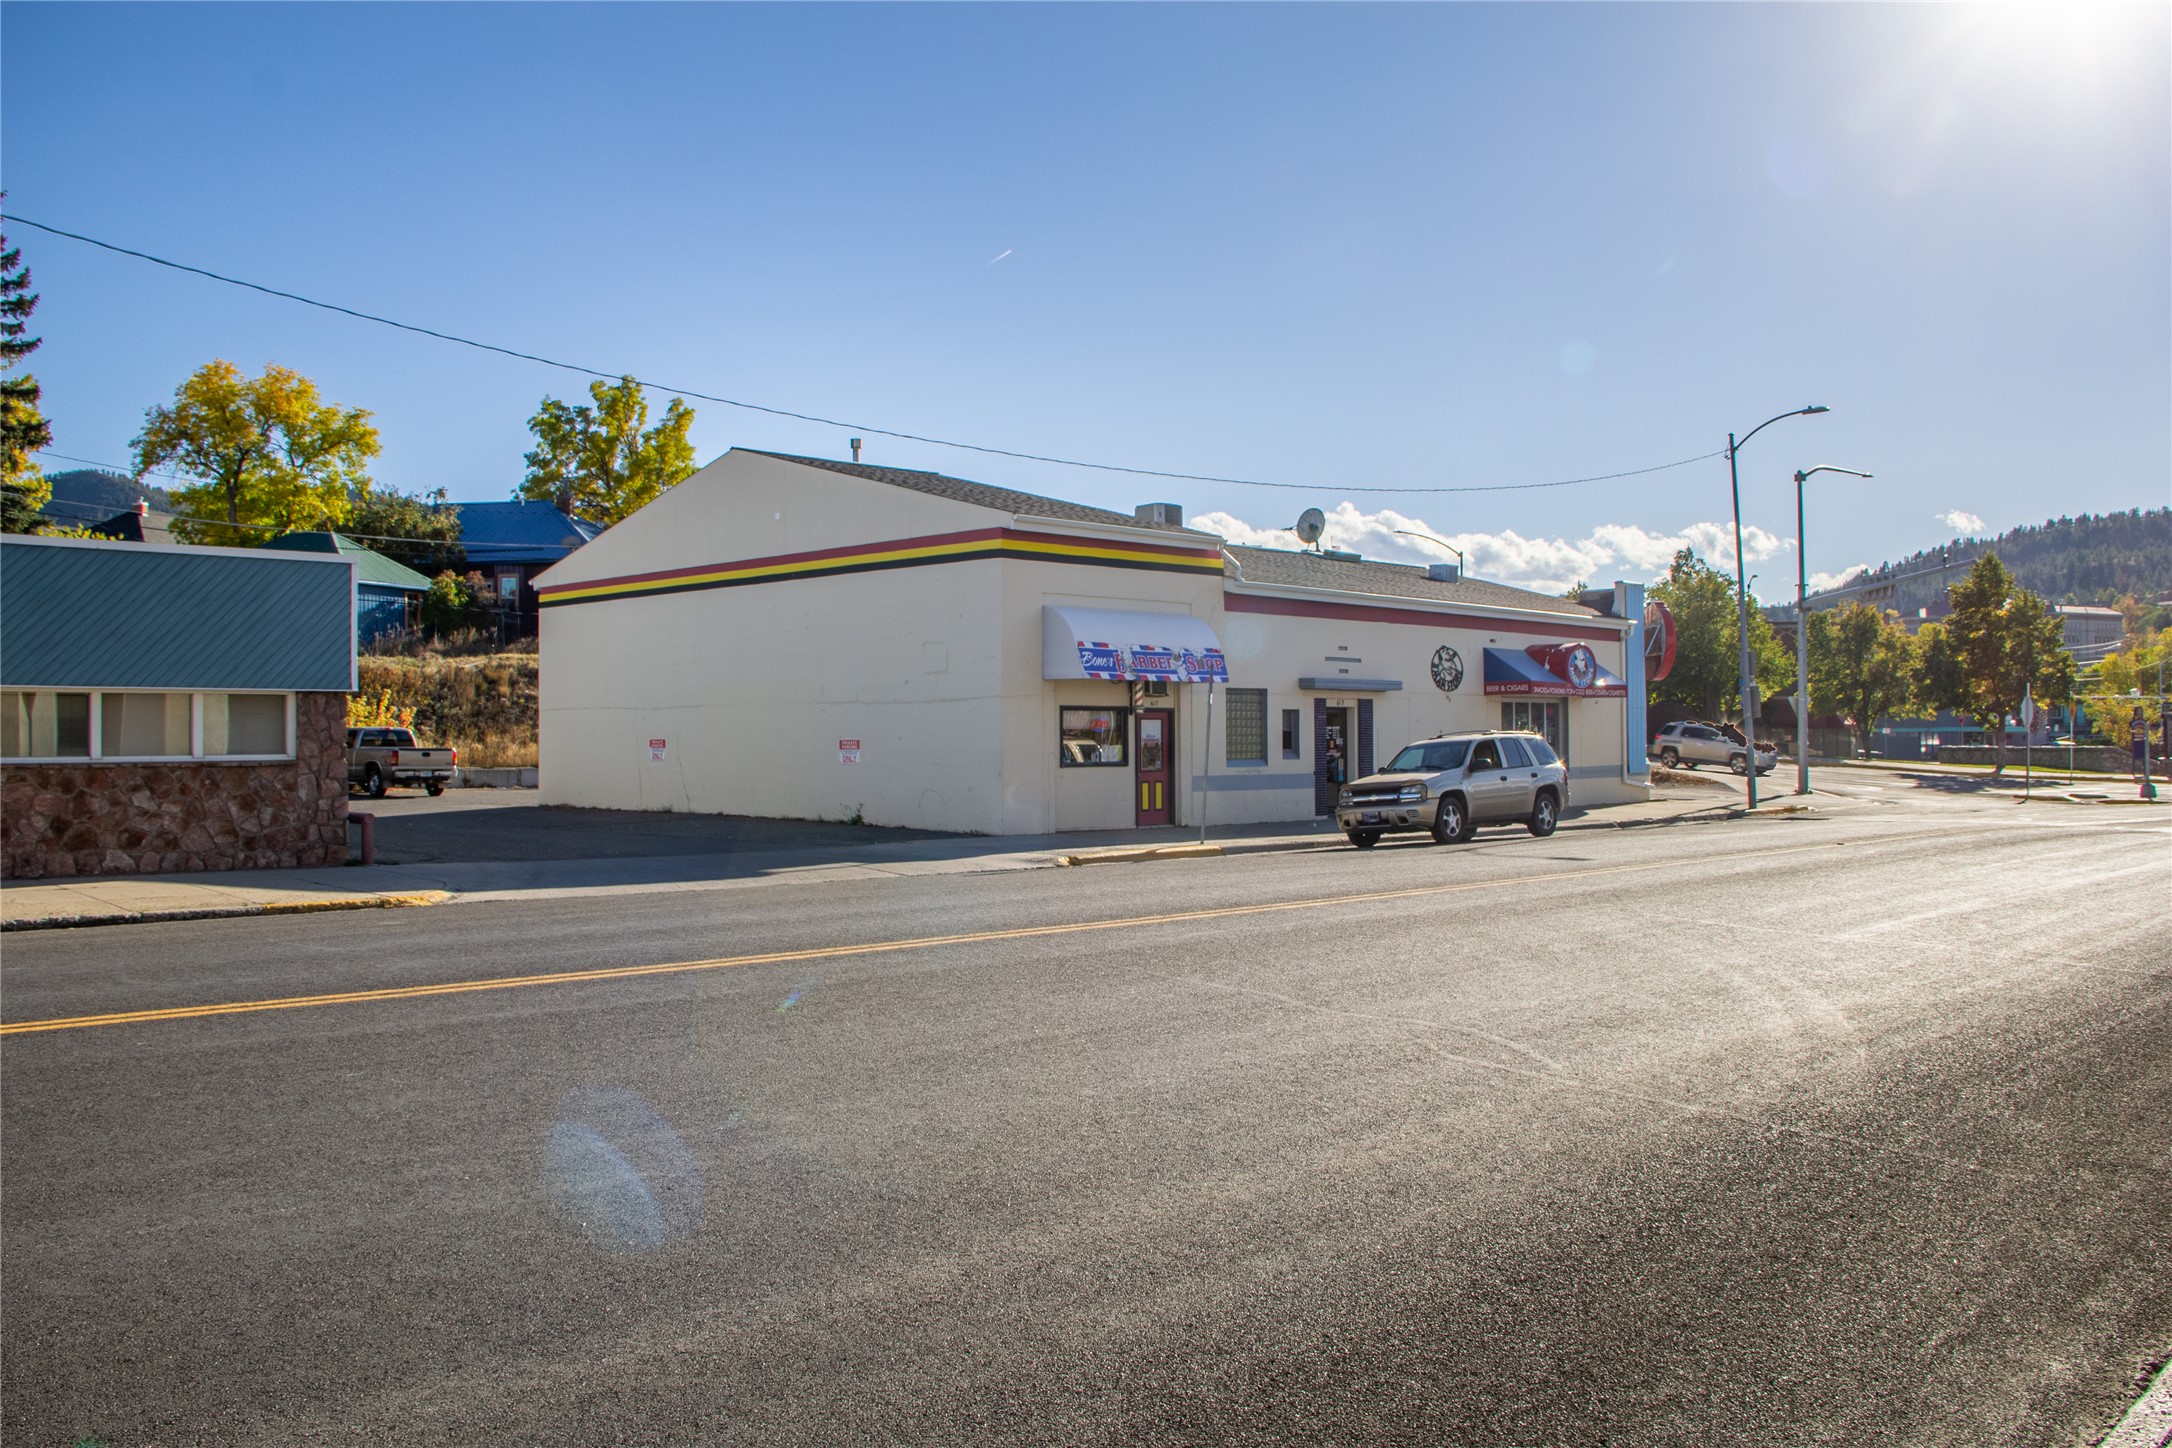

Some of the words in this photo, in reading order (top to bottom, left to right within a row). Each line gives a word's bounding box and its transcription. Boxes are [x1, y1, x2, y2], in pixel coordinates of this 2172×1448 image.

[1081, 651, 1113, 667] Bone's
[651, 752, 663, 760] ONLY
[843, 755, 857, 763] ONLY
